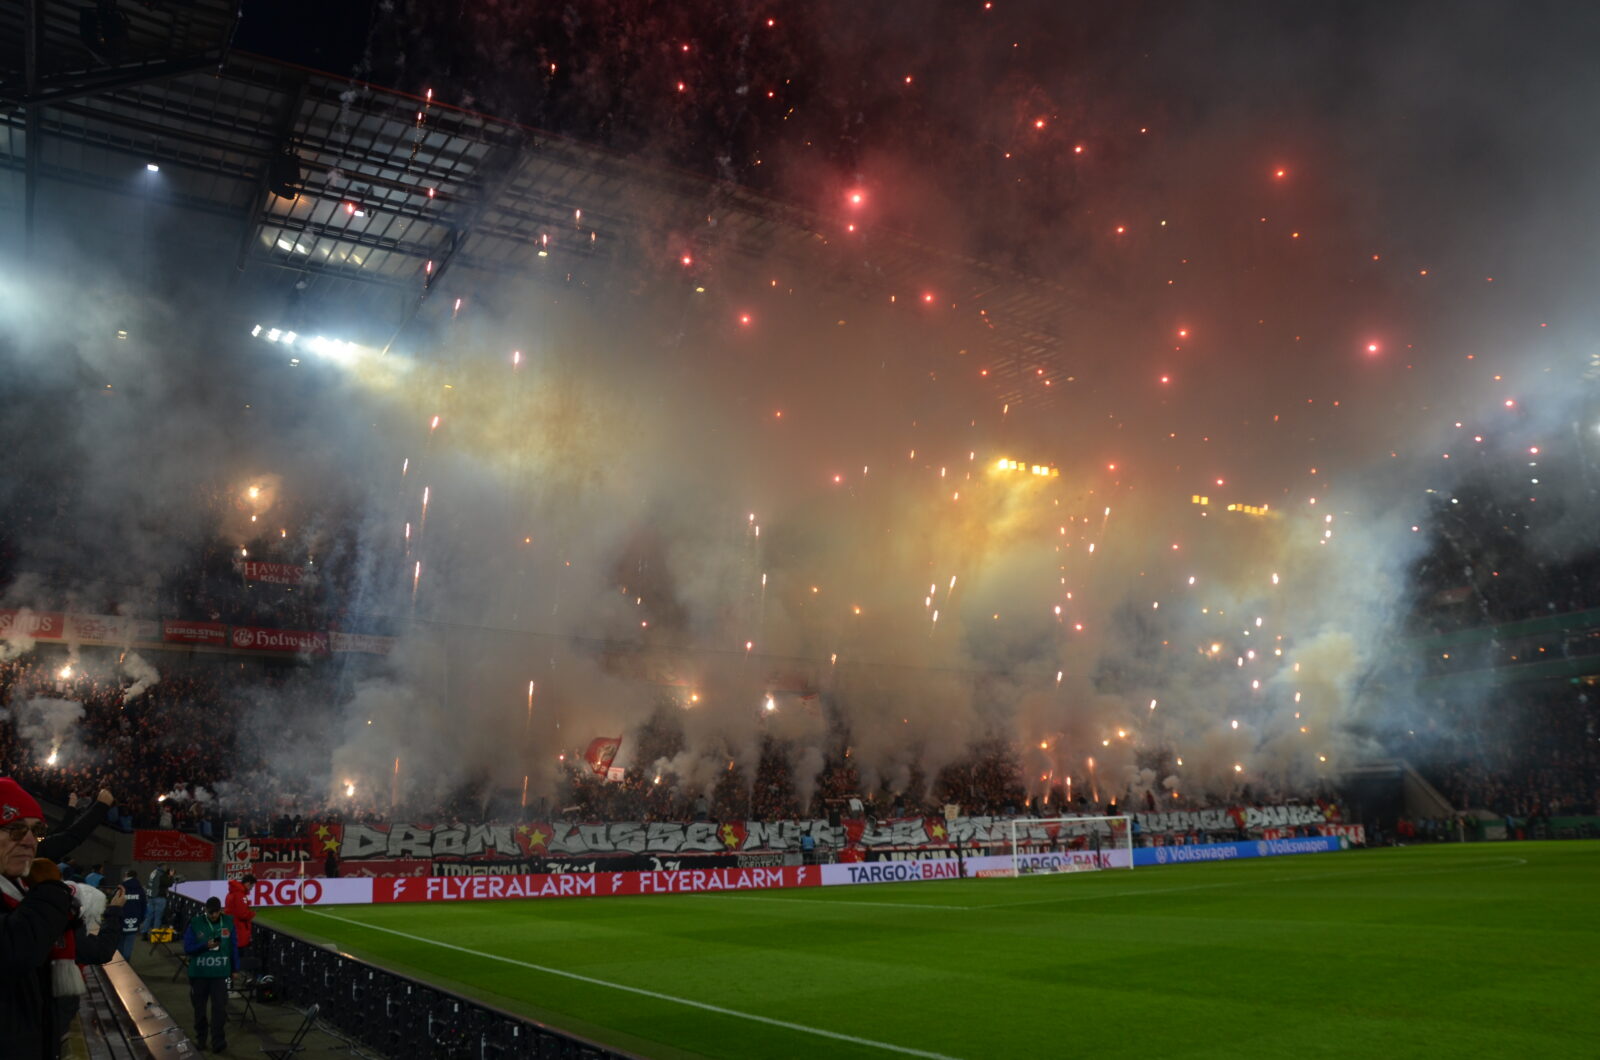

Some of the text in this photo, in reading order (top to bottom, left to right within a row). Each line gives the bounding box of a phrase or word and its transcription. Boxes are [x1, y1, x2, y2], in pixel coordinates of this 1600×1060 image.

[547, 822, 728, 855] LOSSE
[1268, 839, 1329, 854] Volkswagen
[1169, 845, 1238, 862] Volkswagen
[249, 879, 322, 906] RGO
[426, 874, 596, 900] FLYERALARM
[639, 868, 784, 893] FLYERALARM
[196, 956, 229, 967] HOST
